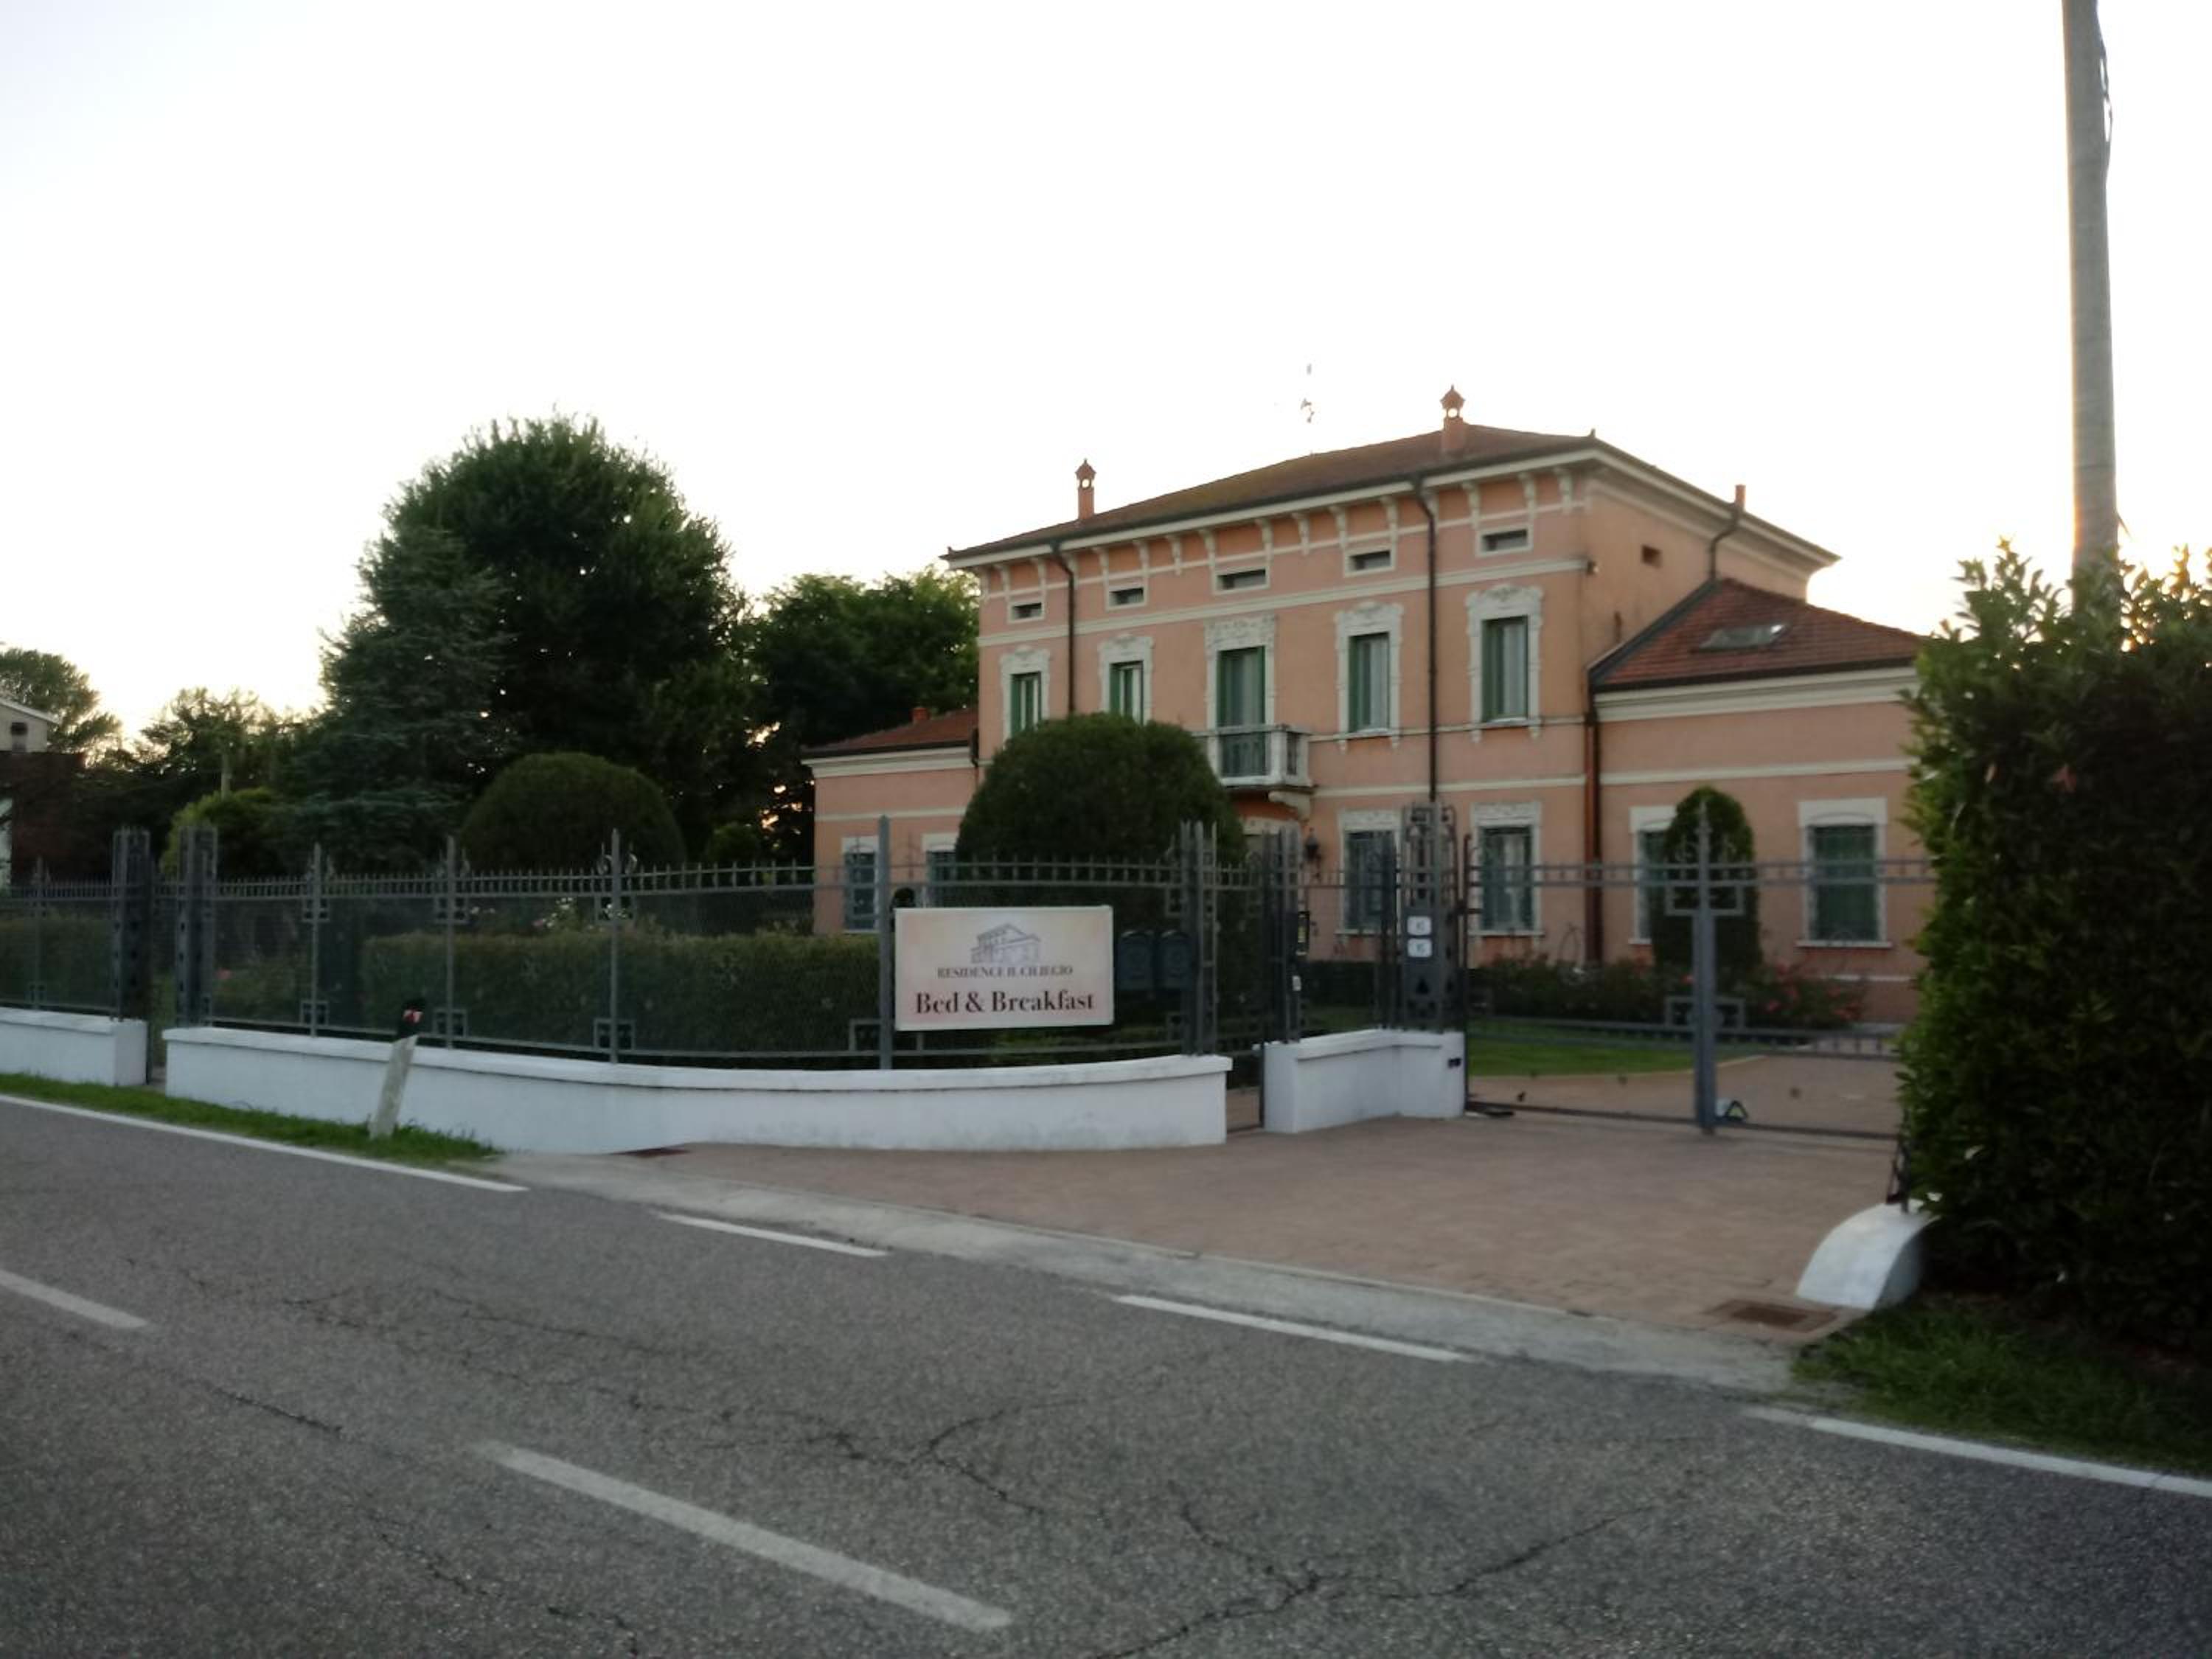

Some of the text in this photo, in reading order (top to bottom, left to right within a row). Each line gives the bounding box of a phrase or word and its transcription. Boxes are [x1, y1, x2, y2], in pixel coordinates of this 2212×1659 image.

[937, 966, 1003, 978] RESIDENCE
[916, 989, 1093, 1014] Bed & Breakfast
